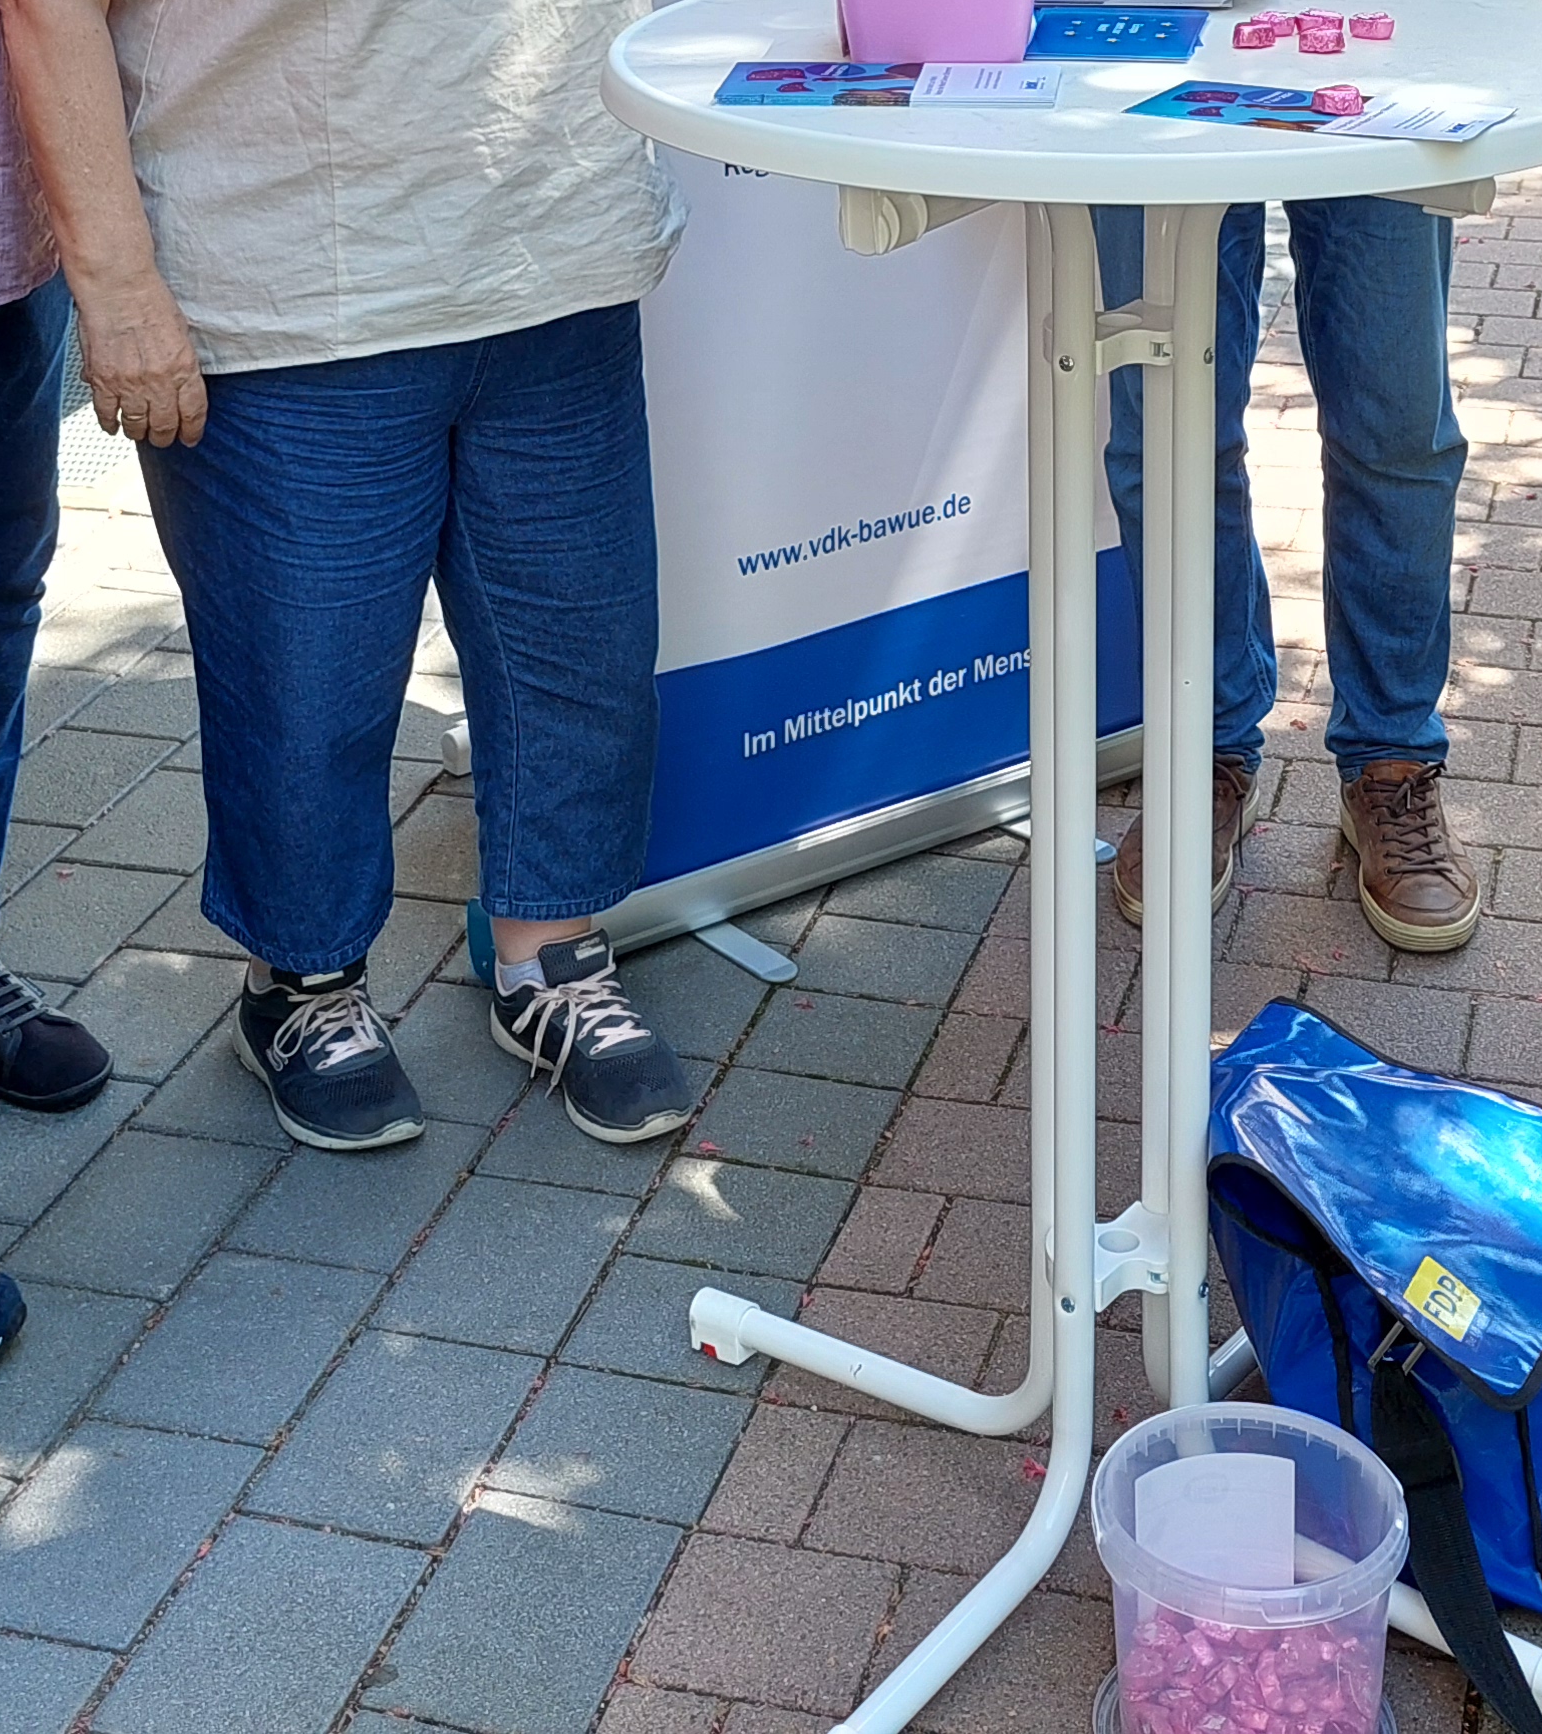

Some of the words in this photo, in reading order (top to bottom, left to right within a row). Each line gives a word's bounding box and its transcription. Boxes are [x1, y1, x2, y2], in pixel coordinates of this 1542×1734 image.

[737, 492, 972, 577] www.vdk-bawue.de
[743, 730, 776, 759] Im
[783, 682, 923, 745] Mittelpunkt
[928, 667, 968, 697] der
[1422, 1274, 1464, 1329] FDP
